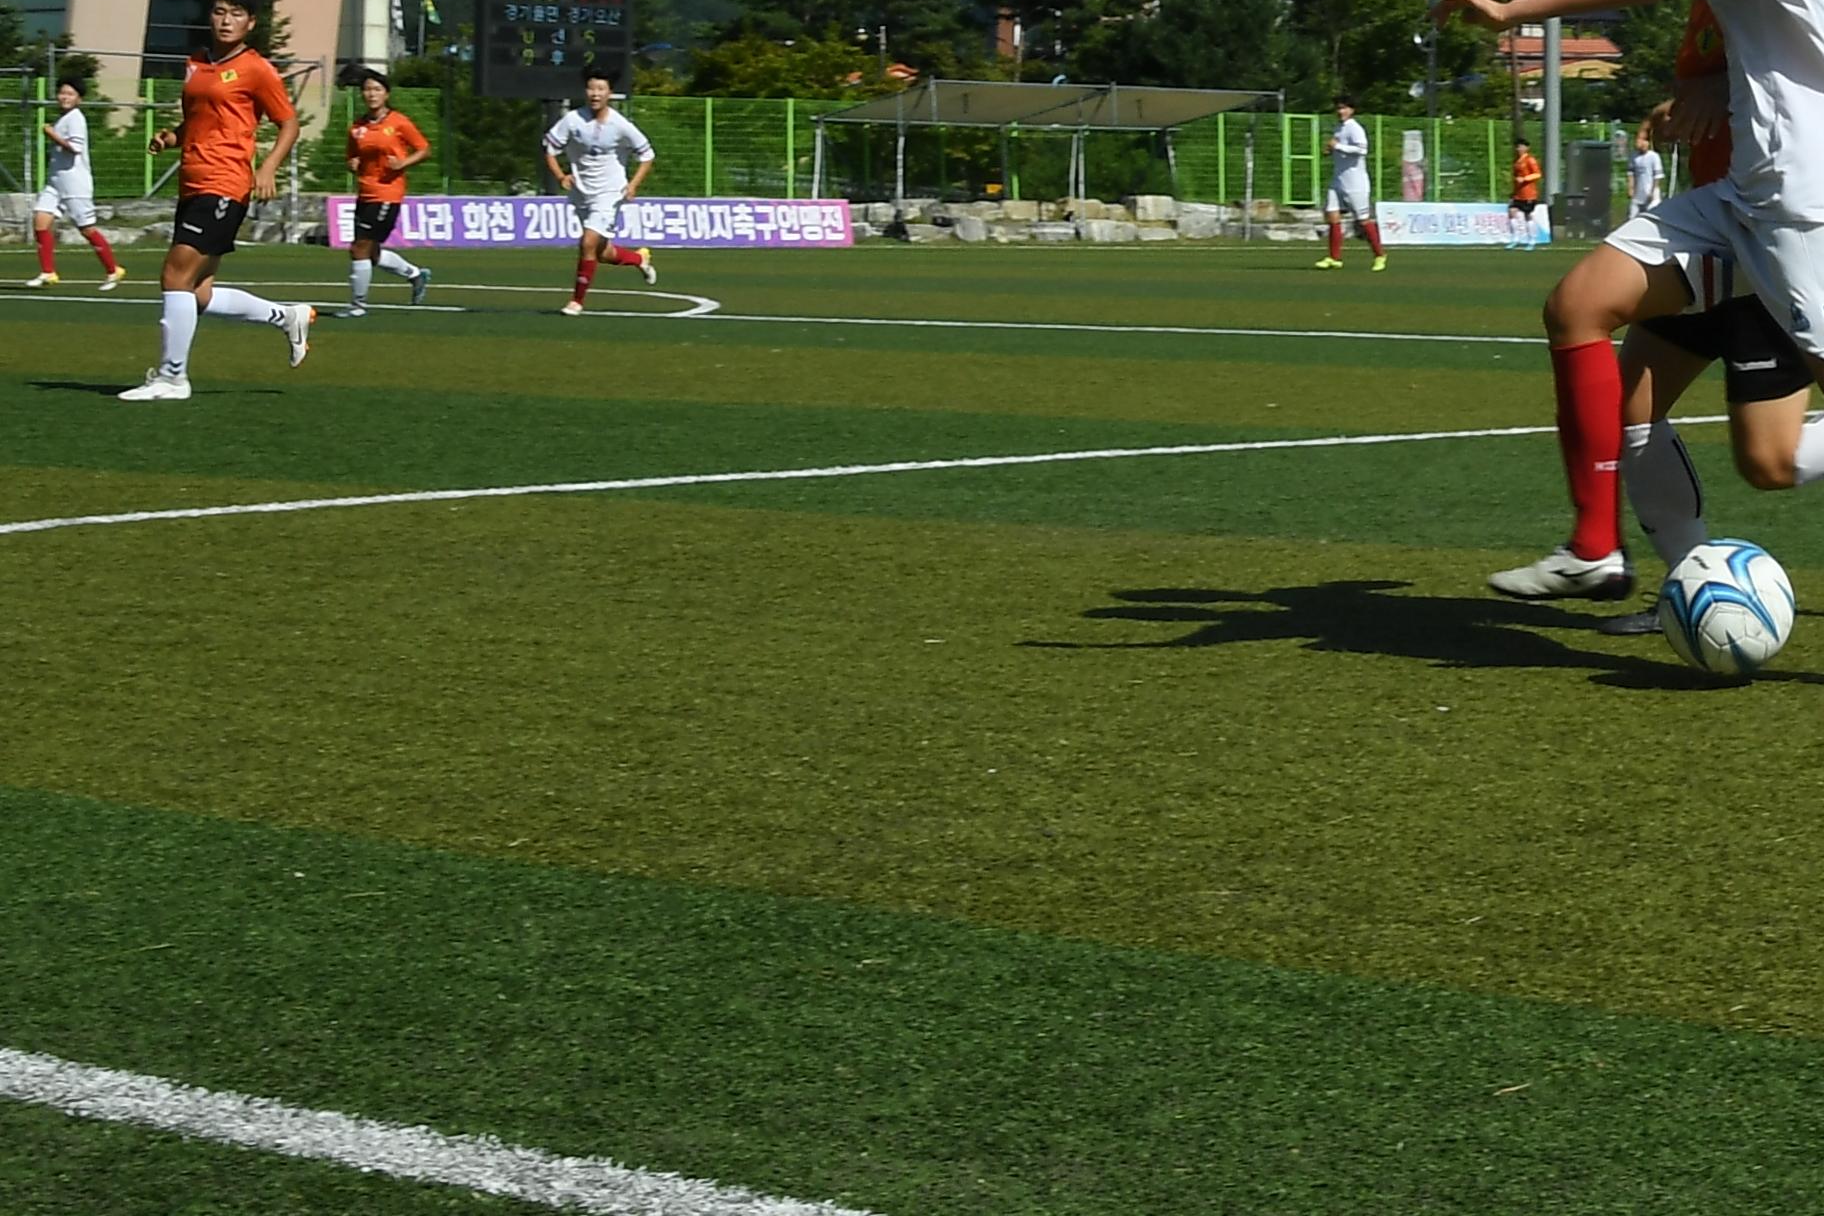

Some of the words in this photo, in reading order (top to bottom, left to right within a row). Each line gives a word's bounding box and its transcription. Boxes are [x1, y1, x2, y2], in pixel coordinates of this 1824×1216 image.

[401, 203, 454, 241] 나라
[461, 202, 516, 241] 화천
[523, 203, 584, 239] 2016
[611, 202, 846, 240] 계한국여자축구연맹전
